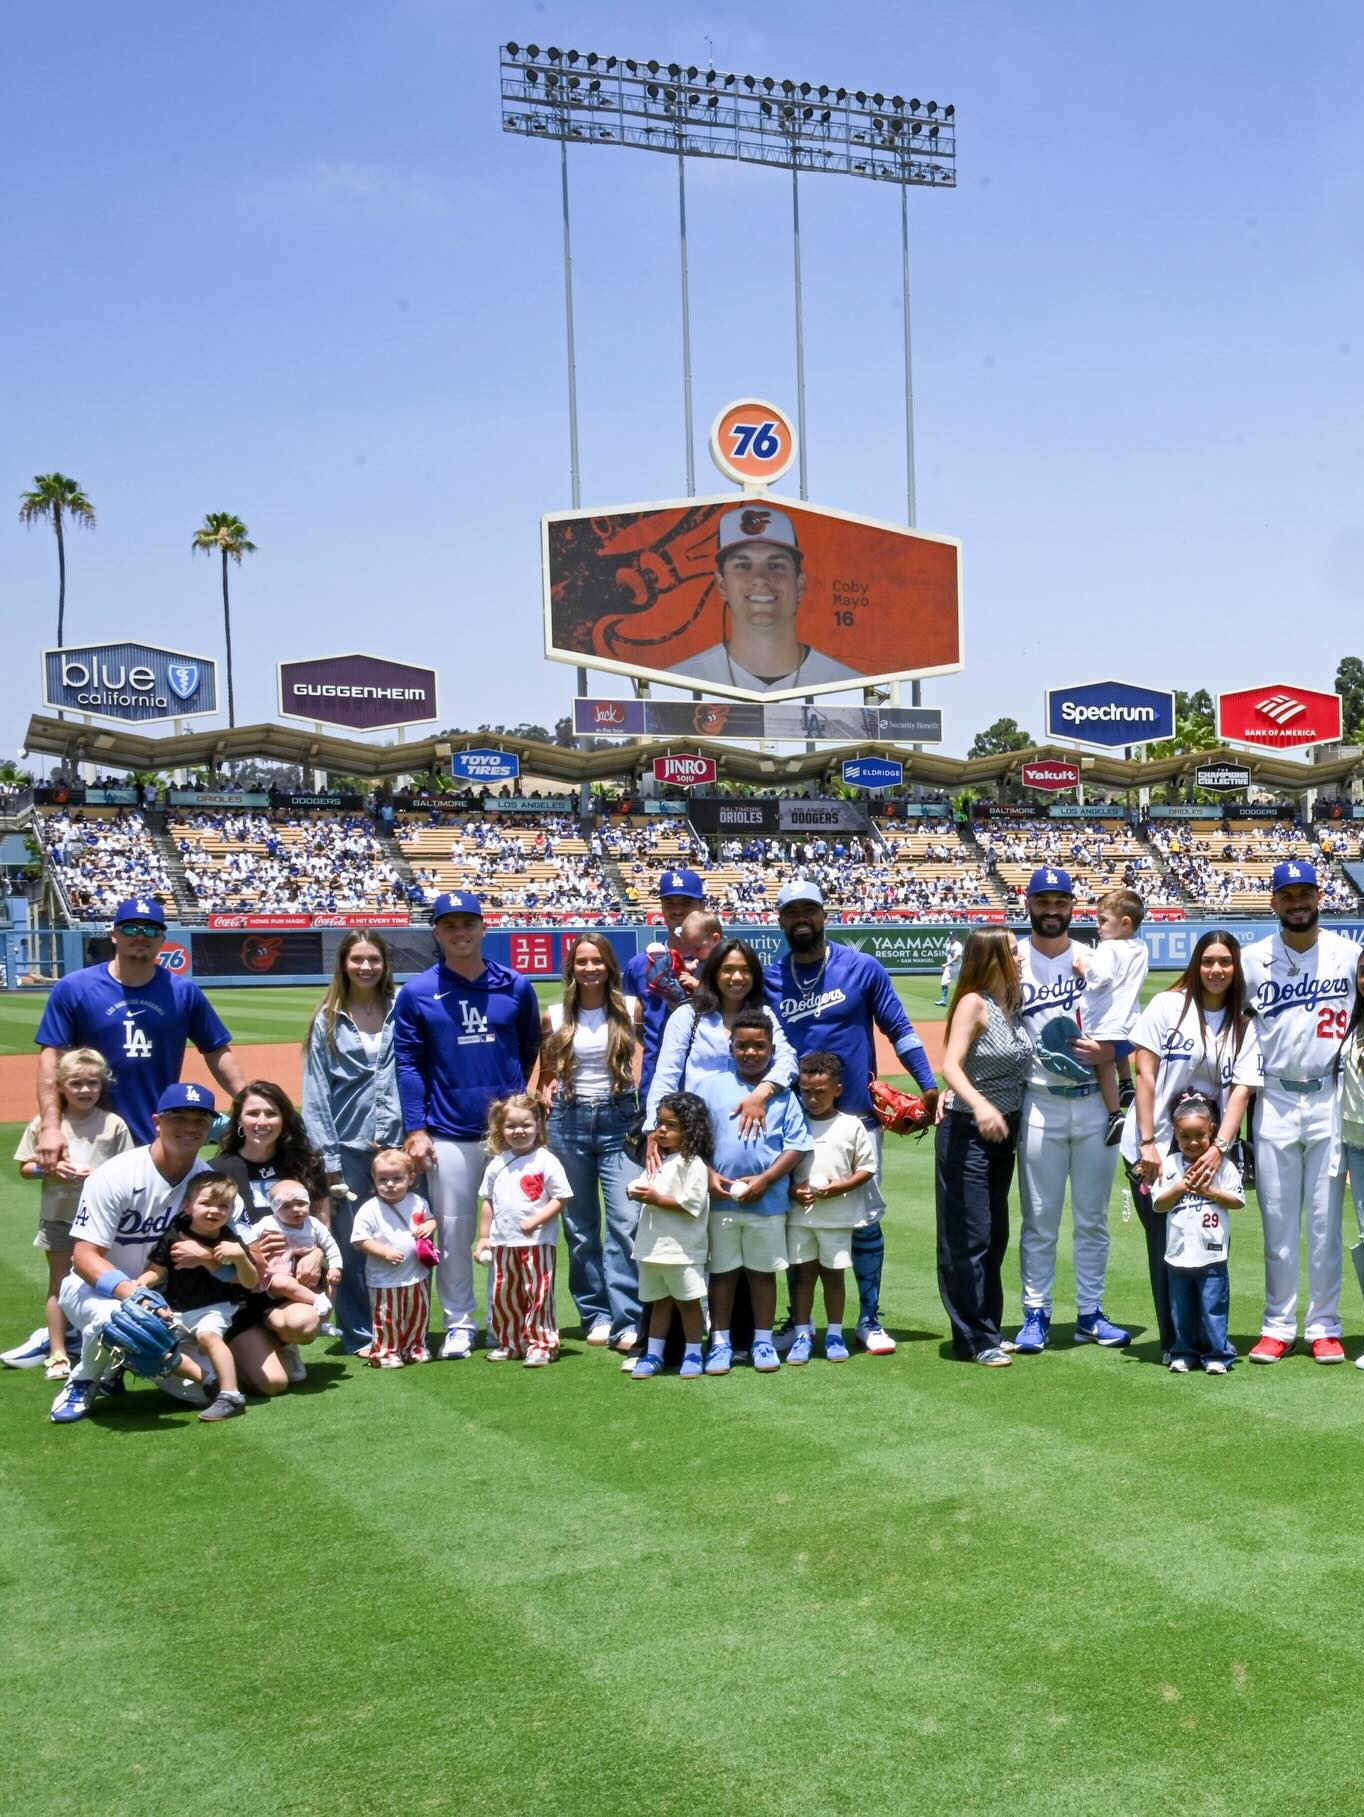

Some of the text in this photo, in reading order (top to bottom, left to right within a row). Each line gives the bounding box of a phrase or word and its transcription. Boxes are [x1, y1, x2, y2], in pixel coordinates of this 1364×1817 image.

[729, 420, 781, 461] 76
[832, 579, 869, 594] Coby
[833, 594, 869, 608] Mayo
[833, 611, 854, 627] 16
[61, 654, 155, 690] blue
[293, 683, 426, 700] GUGGENHEIM
[77, 692, 167, 708] california
[594, 703, 625, 723] Jack
[1061, 701, 1154, 724] Spectrum
[460, 755, 501, 766] TOYO
[664, 759, 707, 778] JINRO
[467, 765, 511, 776] TIRES
[862, 769, 900, 777] ELDRIDGE
[1025, 769, 1077, 781] Yakult
[291, 797, 341, 806] DODGERS
[413, 800, 468, 808] BALTIMORE
[498, 801, 565, 809] LOS ANGELES
[719, 812, 763, 824] ORIOLES
[791, 813, 839, 824] DODGERS
[157, 949, 186, 969] 76
[876, 950, 910, 958] RESORT
[1257, 973, 1349, 1018] Dodgers
[780, 988, 846, 1023] Dodgers
[459, 1000, 488, 1033] LA
[1316, 1007, 1349, 1040] 29
[123, 1020, 152, 1057] LA
[1202, 1213, 1219, 1228] 29
